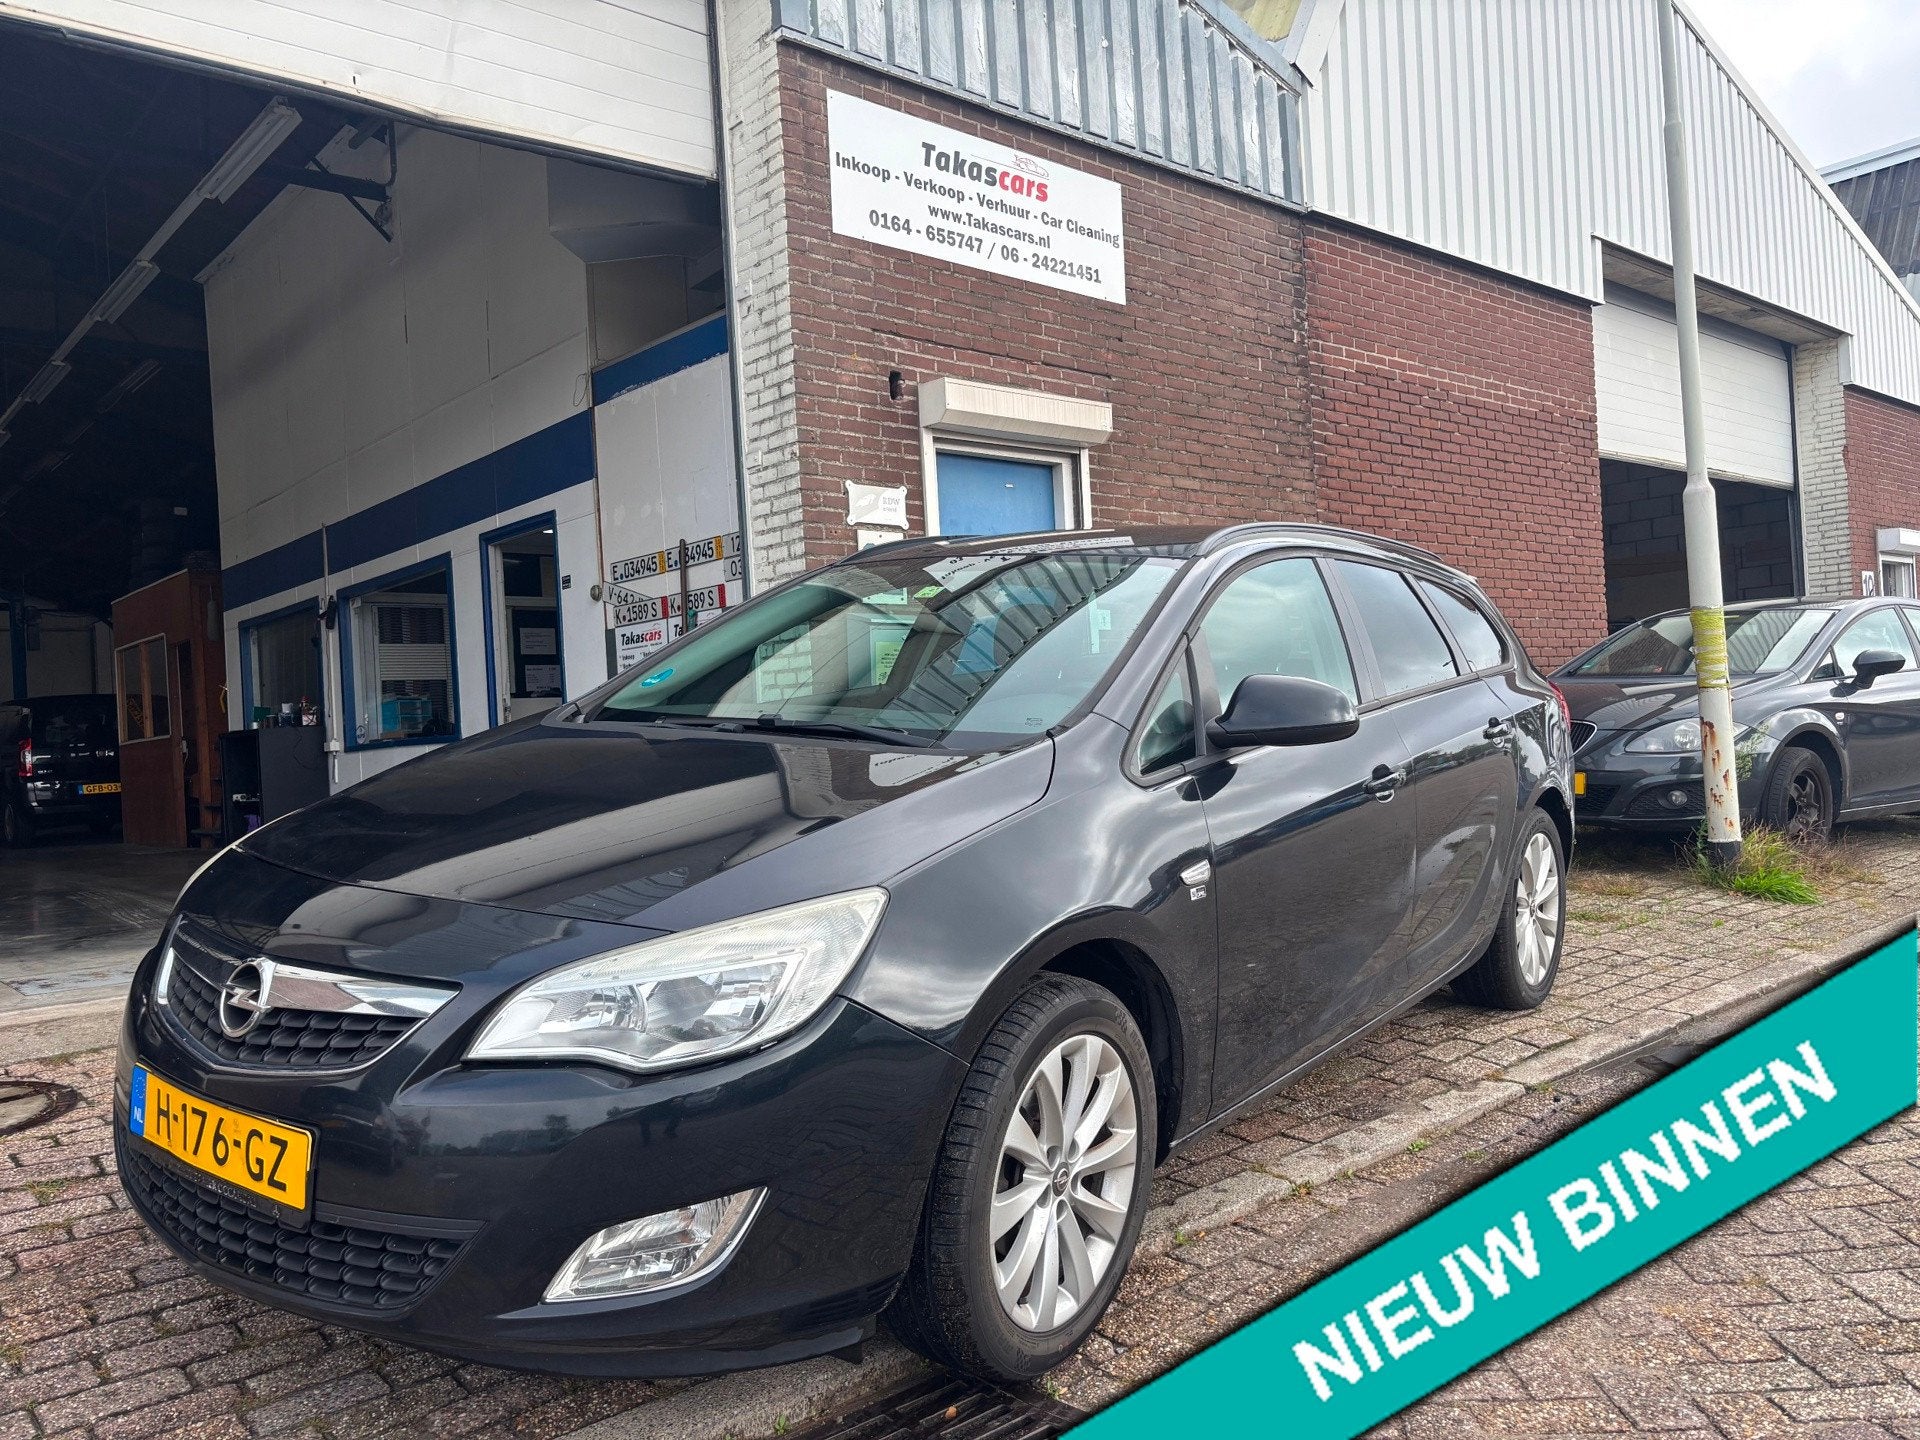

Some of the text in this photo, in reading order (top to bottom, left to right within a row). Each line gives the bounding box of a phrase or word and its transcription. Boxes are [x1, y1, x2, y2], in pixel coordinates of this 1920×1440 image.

[835, 151, 891, 183] Inkoop
[903, 170, 965, 204] Verkoop
[976, 192, 1031, 220] Verhuur
[1040, 211, 1063, 230] Car
[1066, 218, 1120, 249] Cleaning
[921, 141, 1049, 203] Takascars
[868, 209, 913, 236] 0164
[925, 224, 983, 254] 655747
[1000, 244, 1020, 263] 06
[1031, 252, 1102, 284] 24221451
[927, 204, 1051, 249] www.Takascars.nl
[620, 629, 662, 646] Takascars
[133, 1106, 144, 1124] NL
[156, 1088, 287, 1192] H-176-GZ
